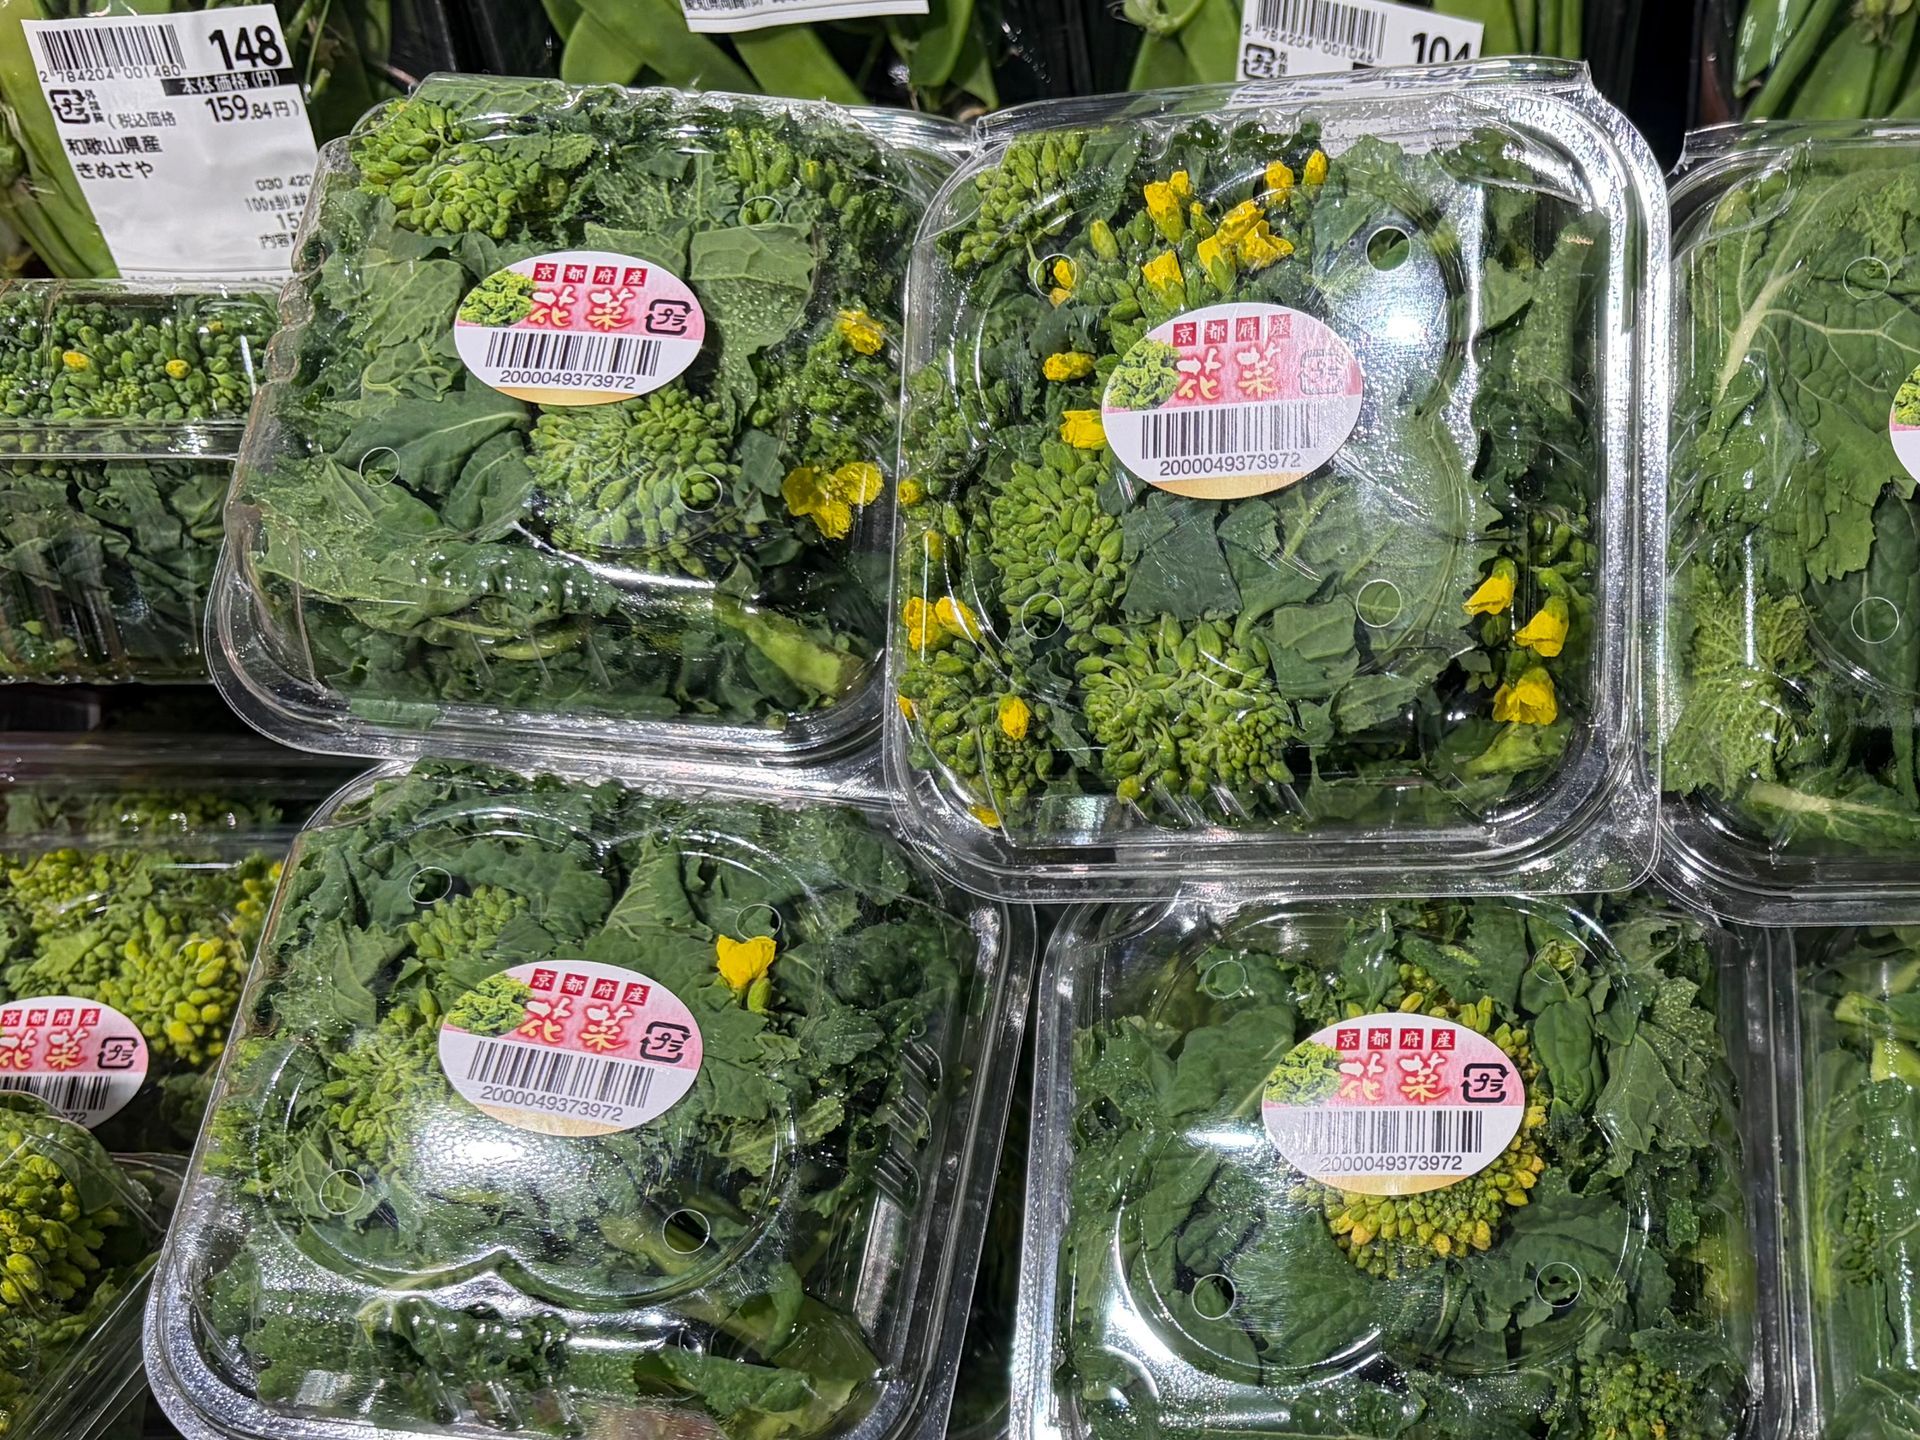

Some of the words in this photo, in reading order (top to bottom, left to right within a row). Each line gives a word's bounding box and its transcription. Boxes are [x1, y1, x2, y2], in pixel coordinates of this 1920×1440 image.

[208, 25, 283, 70] 148
[1244, 24, 1252, 36] 2
[1262, 28, 1313, 50] 784204
[1412, 32, 1472, 65] 104
[39, 71, 49, 83] 2
[57, 68, 115, 83] 784204
[124, 64, 181, 79] 001480
[66, 136, 163, 156] 和歌山県産
[76, 160, 154, 180] きぬさや
[535, 263, 646, 286] 京都府産
[529, 285, 635, 331] 花菜
[1174, 315, 1292, 345] 京都府産
[499, 370, 636, 390] 2000049373972
[1175, 342, 1282, 401] 花菜
[1160, 452, 1302, 477] 2000049373972
[532, 969, 649, 1005] 京都府産
[2, 1009, 99, 1026] 京都府産
[518, 997, 634, 1051] 花菜
[1338, 1029, 1454, 1050] 京都府産
[1338, 1052, 1449, 1103] 花菜
[480, 1086, 623, 1122] 2000049373972
[1320, 1155, 1463, 1172] 2000049373972
